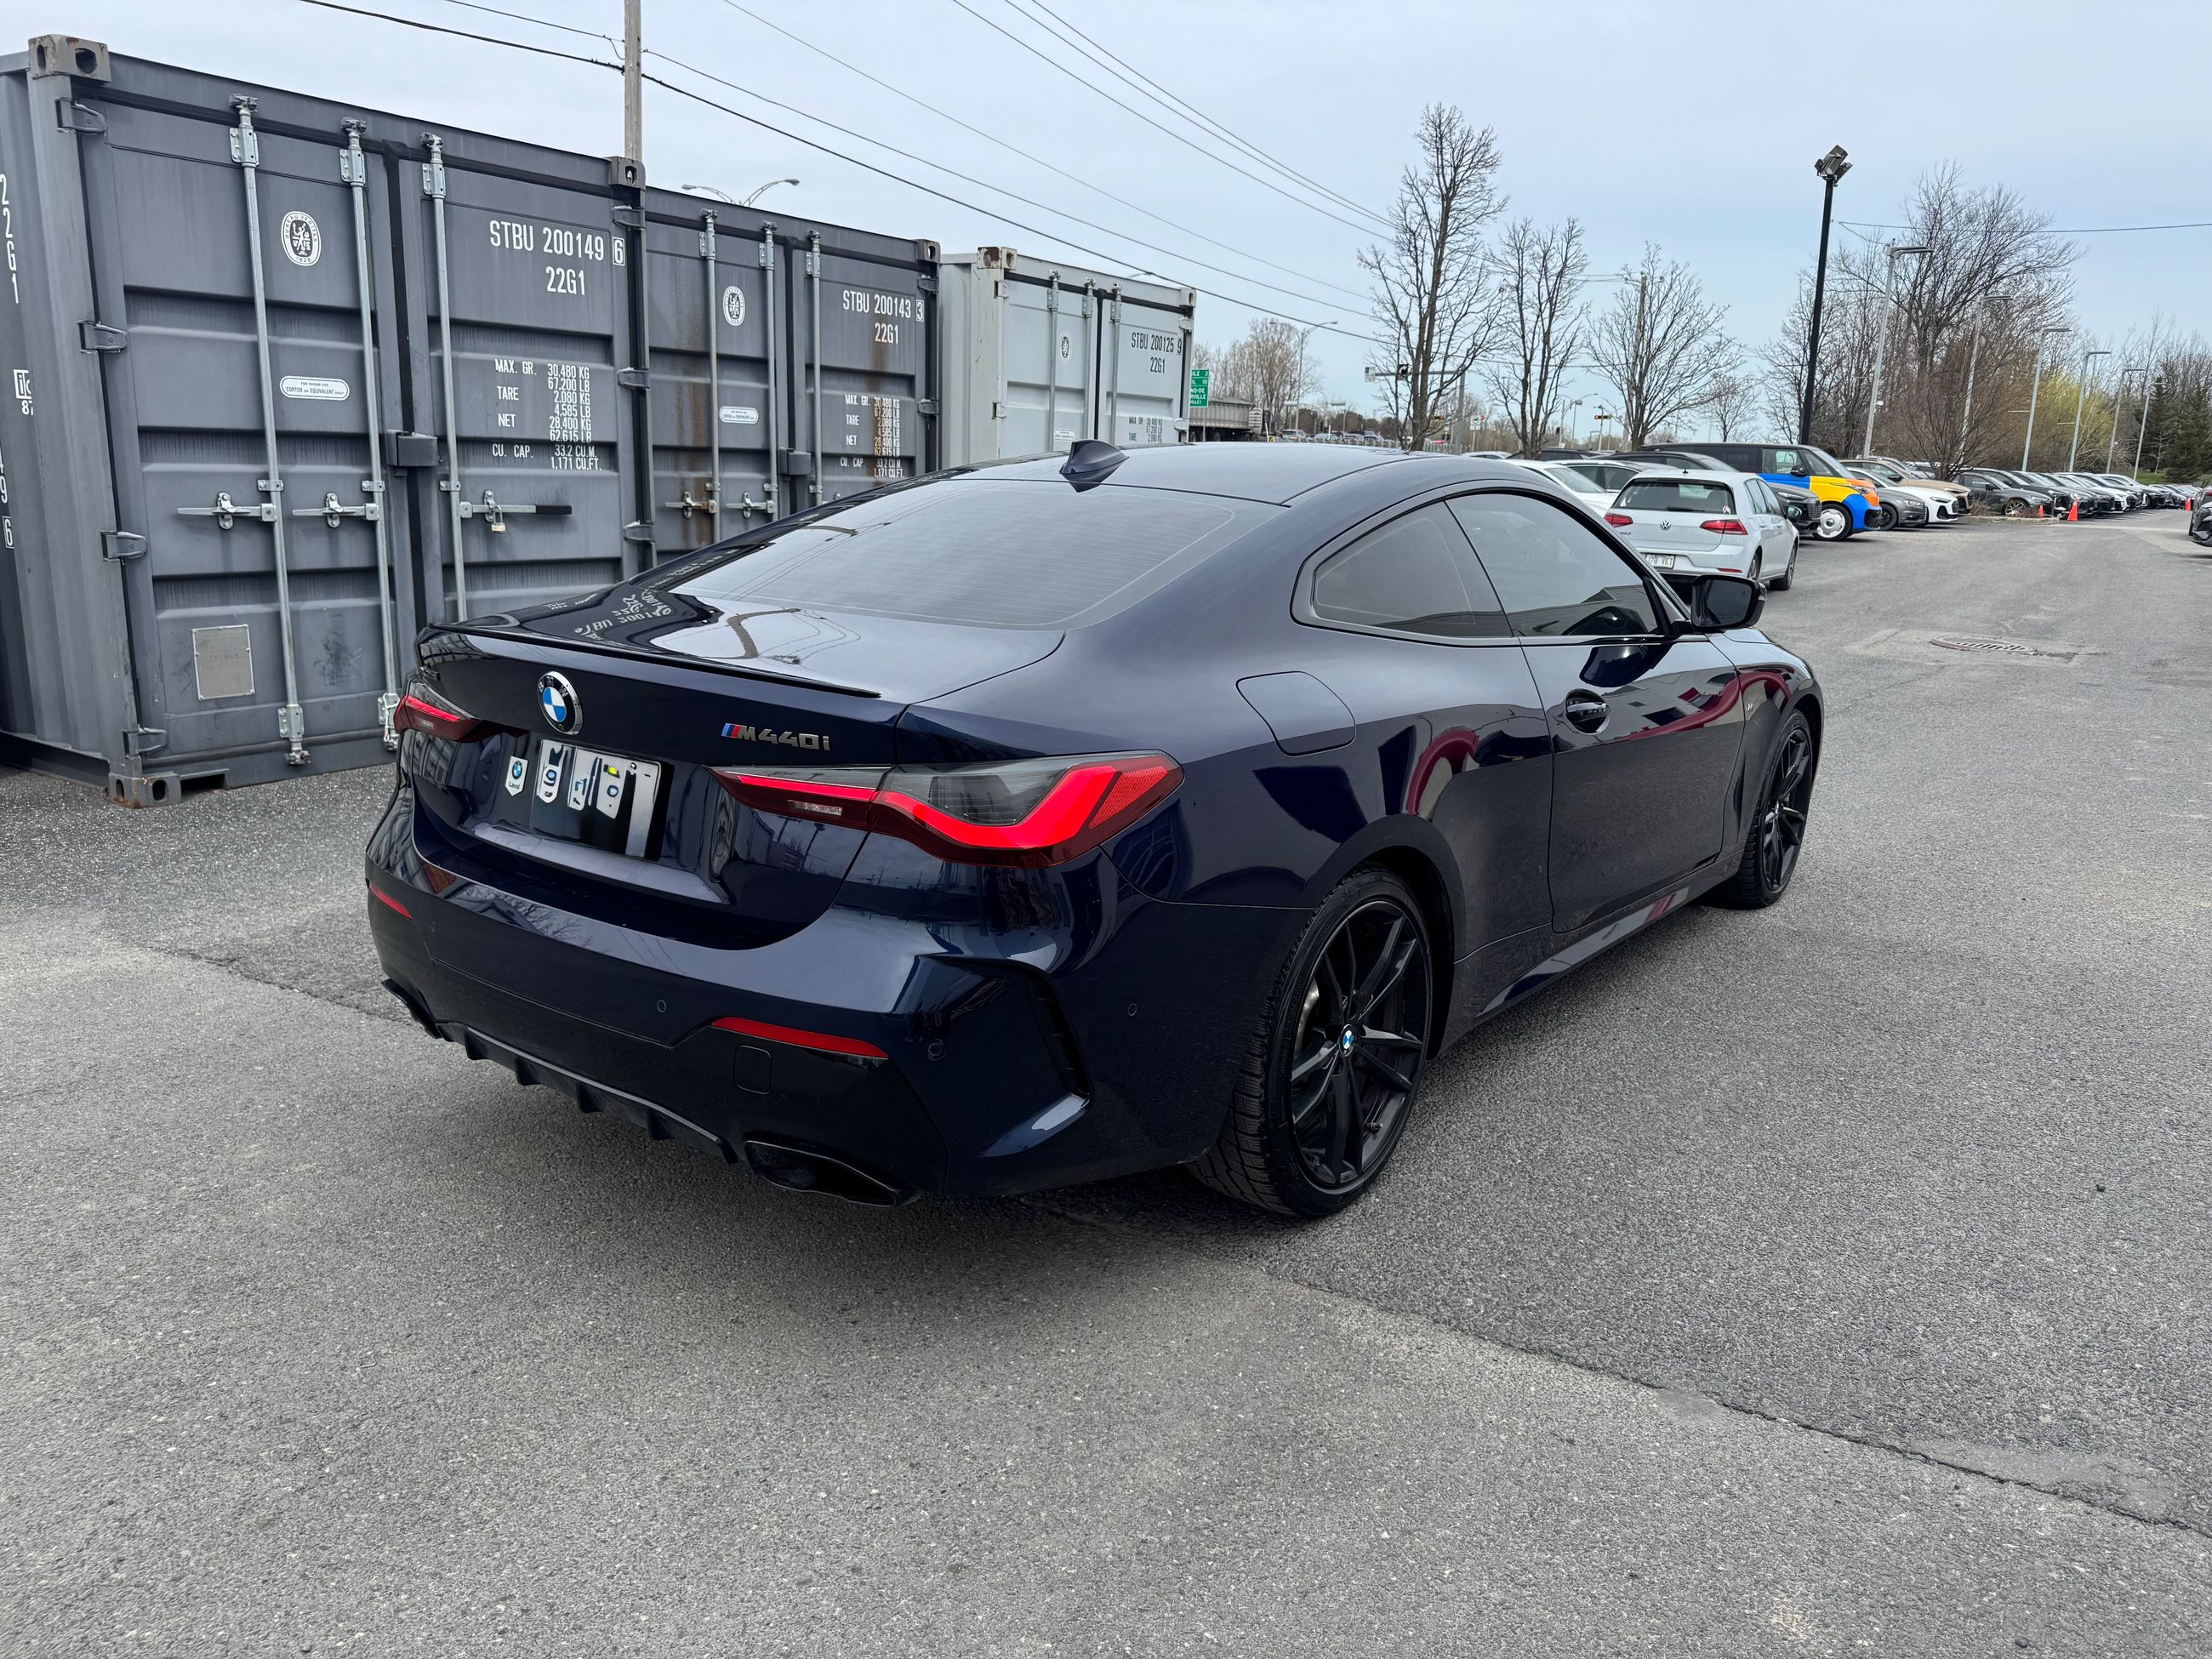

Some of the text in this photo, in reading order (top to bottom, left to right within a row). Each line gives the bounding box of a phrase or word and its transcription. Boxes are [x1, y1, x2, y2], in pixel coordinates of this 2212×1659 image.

[0, 174, 19, 304] 22G1
[489, 219, 624, 264] STBU 200149 6
[545, 266, 585, 295] 22G1
[843, 290, 923, 320] STBU 200143 3
[875, 322, 898, 345] 22G1
[1132, 332, 1182, 354] STBU 200125 9
[494, 358, 590, 379] MAX. GR. 30,480 KG
[1150, 356, 1166, 373] 22G1
[548, 377, 590, 392] 67,200 LB
[497, 385, 519, 401] TARE
[554, 391, 590, 405] 2,080 KG
[845, 394, 859, 405] MAX.
[861, 396, 870, 406] GR.
[892, 398, 900, 408] KG
[554, 405, 590, 418] 4,585 LB
[893, 408, 900, 419] LB
[498, 413, 516, 427] NET
[549, 416, 591, 430] 28,400 KG
[846, 413, 859, 425] TARE
[892, 419, 900, 429] KG
[581, 430, 591, 442] LB
[893, 428, 900, 438] LB
[846, 435, 857, 446] NET
[892, 437, 900, 448] KG
[492, 443, 597, 459] CU. CAP. 33.2 CU.M.
[575, 458, 602, 470] CU.FT.
[840, 457, 850, 467] CU.
[852, 458, 865, 468] CAP.
[736, 725, 830, 751] M440i
[509, 781, 520, 790] Laval
